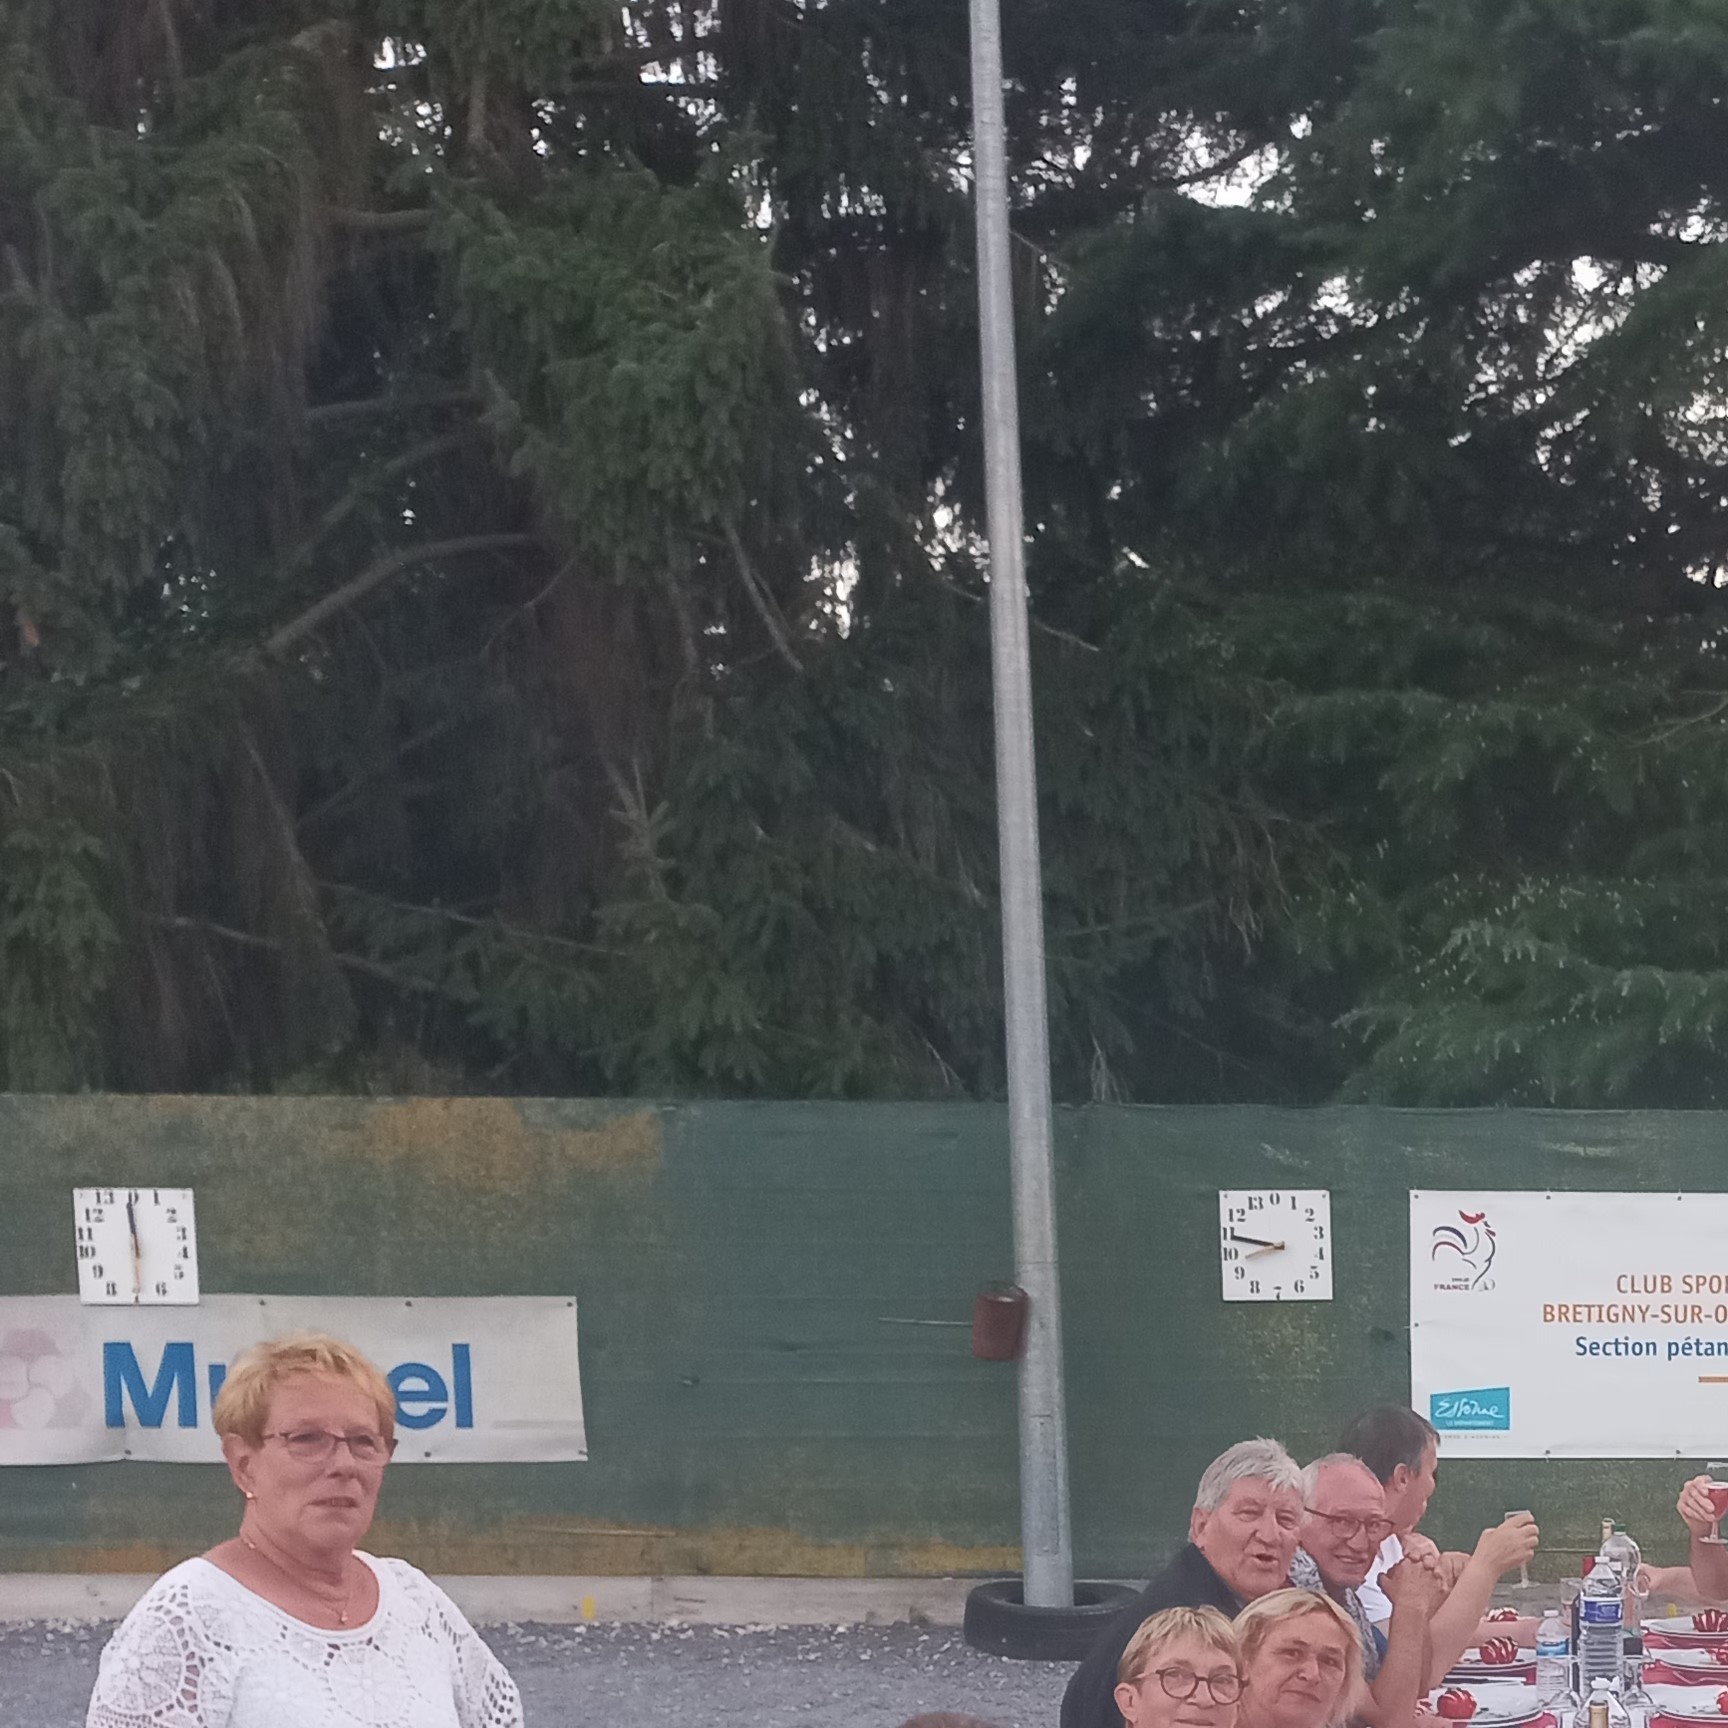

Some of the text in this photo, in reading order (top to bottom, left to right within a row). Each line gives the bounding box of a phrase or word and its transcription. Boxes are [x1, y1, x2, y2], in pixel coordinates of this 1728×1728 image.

[153, 1189, 160, 1206] 1
[1248, 1196, 1264, 1210] 13
[1269, 1193, 1280, 1205] 0
[1290, 1196, 1297, 1210] 1
[85, 1207, 104, 1223] 12
[166, 1207, 177, 1223] 2
[1228, 1208, 1246, 1222] 12
[1304, 1208, 1315, 1222] 2
[78, 1226, 93, 1241] 11
[1222, 1226, 1235, 1241] 11
[1313, 1226, 1324, 1240] 3
[80, 1245, 96, 1259] 10
[1223, 1247, 1239, 1261] 10
[92, 1264, 103, 1278] 9
[174, 1264, 184, 1279] 5
[1234, 1266, 1245, 1280] 9
[1309, 1265, 1319, 1279] 5
[155, 1281, 167, 1296] 6
[1249, 1280, 1260, 1294] 8
[1294, 1280, 1304, 1293] 6
[1616, 1274, 1673, 1294] CLUB
[1273, 1286, 1282, 1301] 7
[1575, 1336, 1658, 1356] Section
